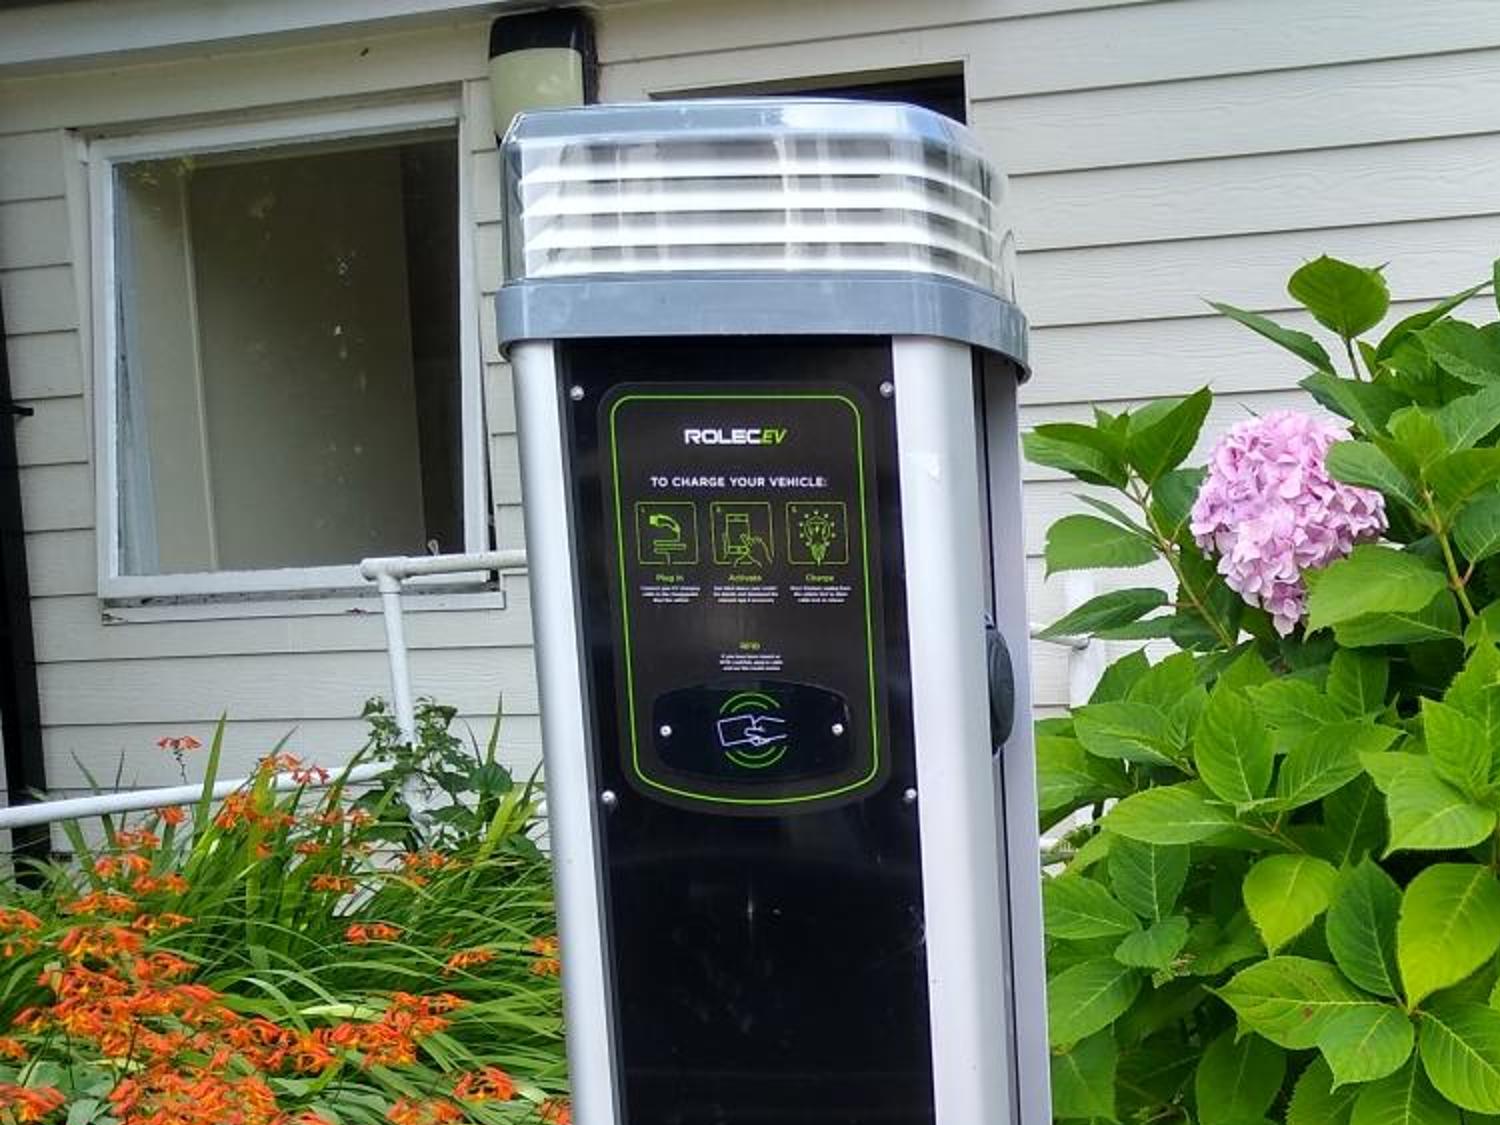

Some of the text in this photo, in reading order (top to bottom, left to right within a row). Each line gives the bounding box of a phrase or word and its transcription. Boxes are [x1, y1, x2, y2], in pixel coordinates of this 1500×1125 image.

[651, 477, 827, 487] TO CHARGE YOUR VEHICLE:
